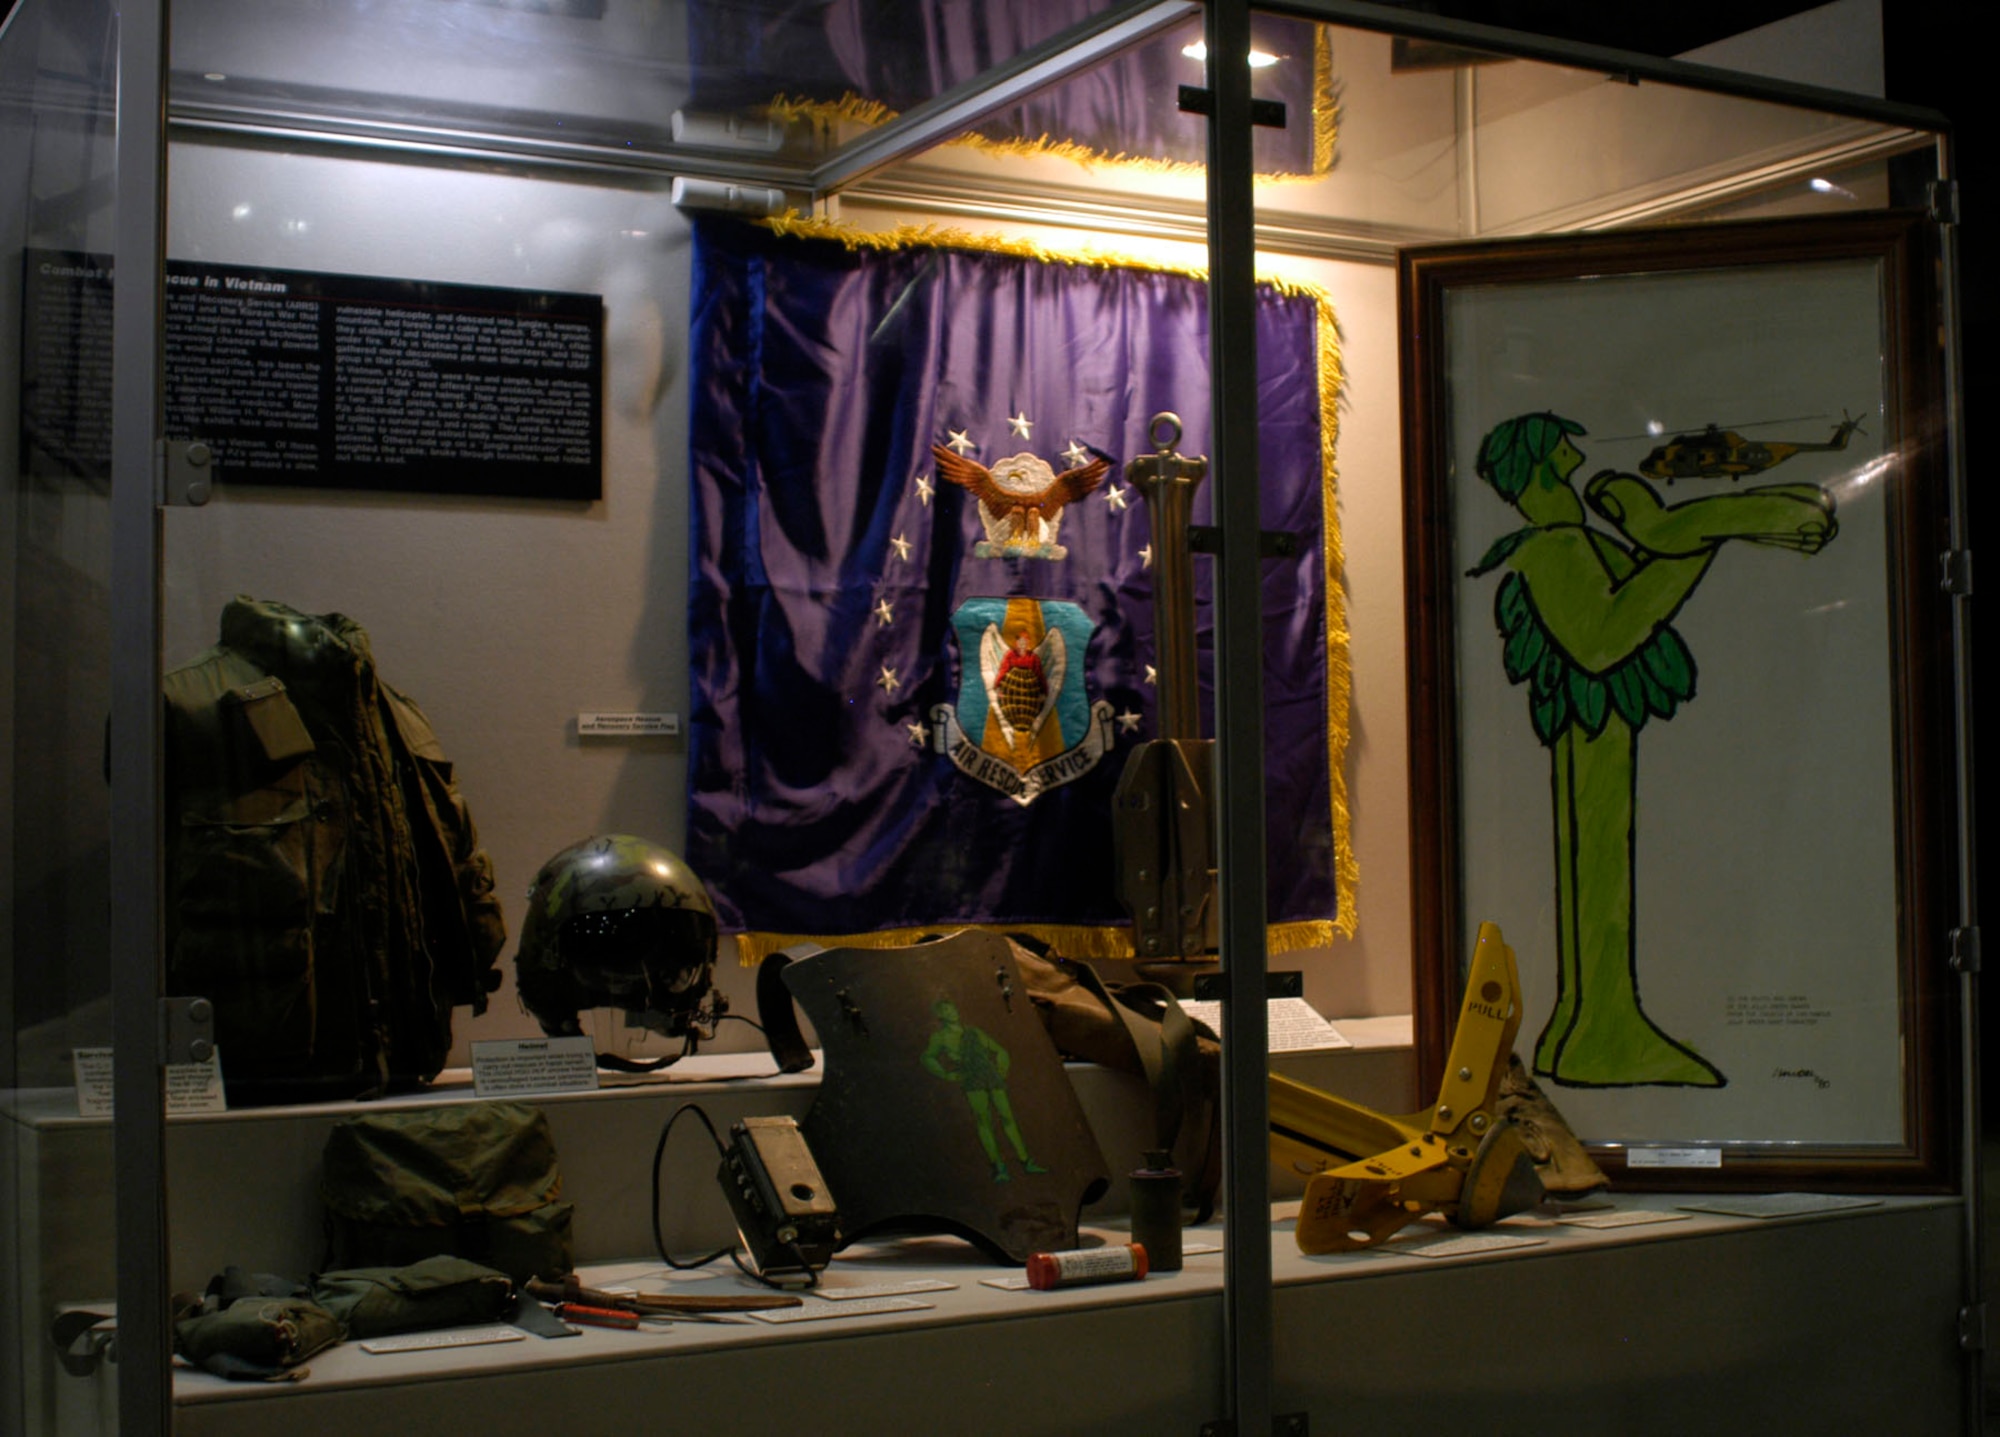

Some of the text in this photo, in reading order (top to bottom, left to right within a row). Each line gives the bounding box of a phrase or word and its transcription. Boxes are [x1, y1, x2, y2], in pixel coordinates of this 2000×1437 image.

[204, 275, 219, 288] in
[225, 277, 287, 293] Vietnam
[953, 741, 978, 770] AIR
[1030, 747, 1092, 793] SERVICE
[1468, 1001, 1505, 1021] PULL
